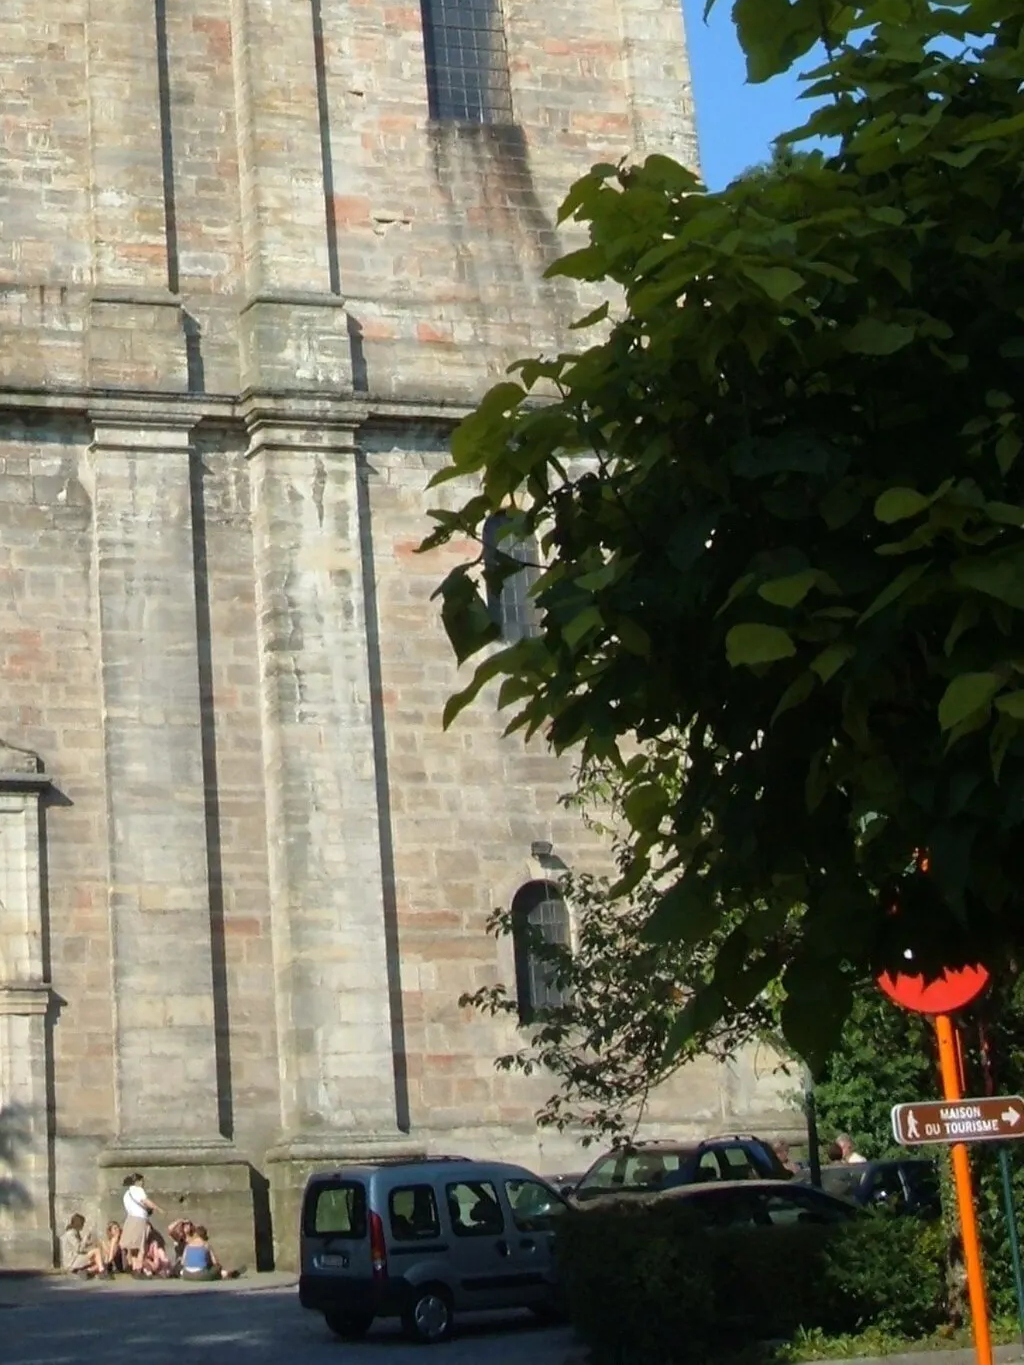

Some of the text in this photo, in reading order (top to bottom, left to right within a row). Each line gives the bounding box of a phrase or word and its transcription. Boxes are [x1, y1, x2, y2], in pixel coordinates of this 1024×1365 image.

[940, 1106, 981, 1119] MAISON
[925, 1119, 1000, 1136] DU TOURISME
